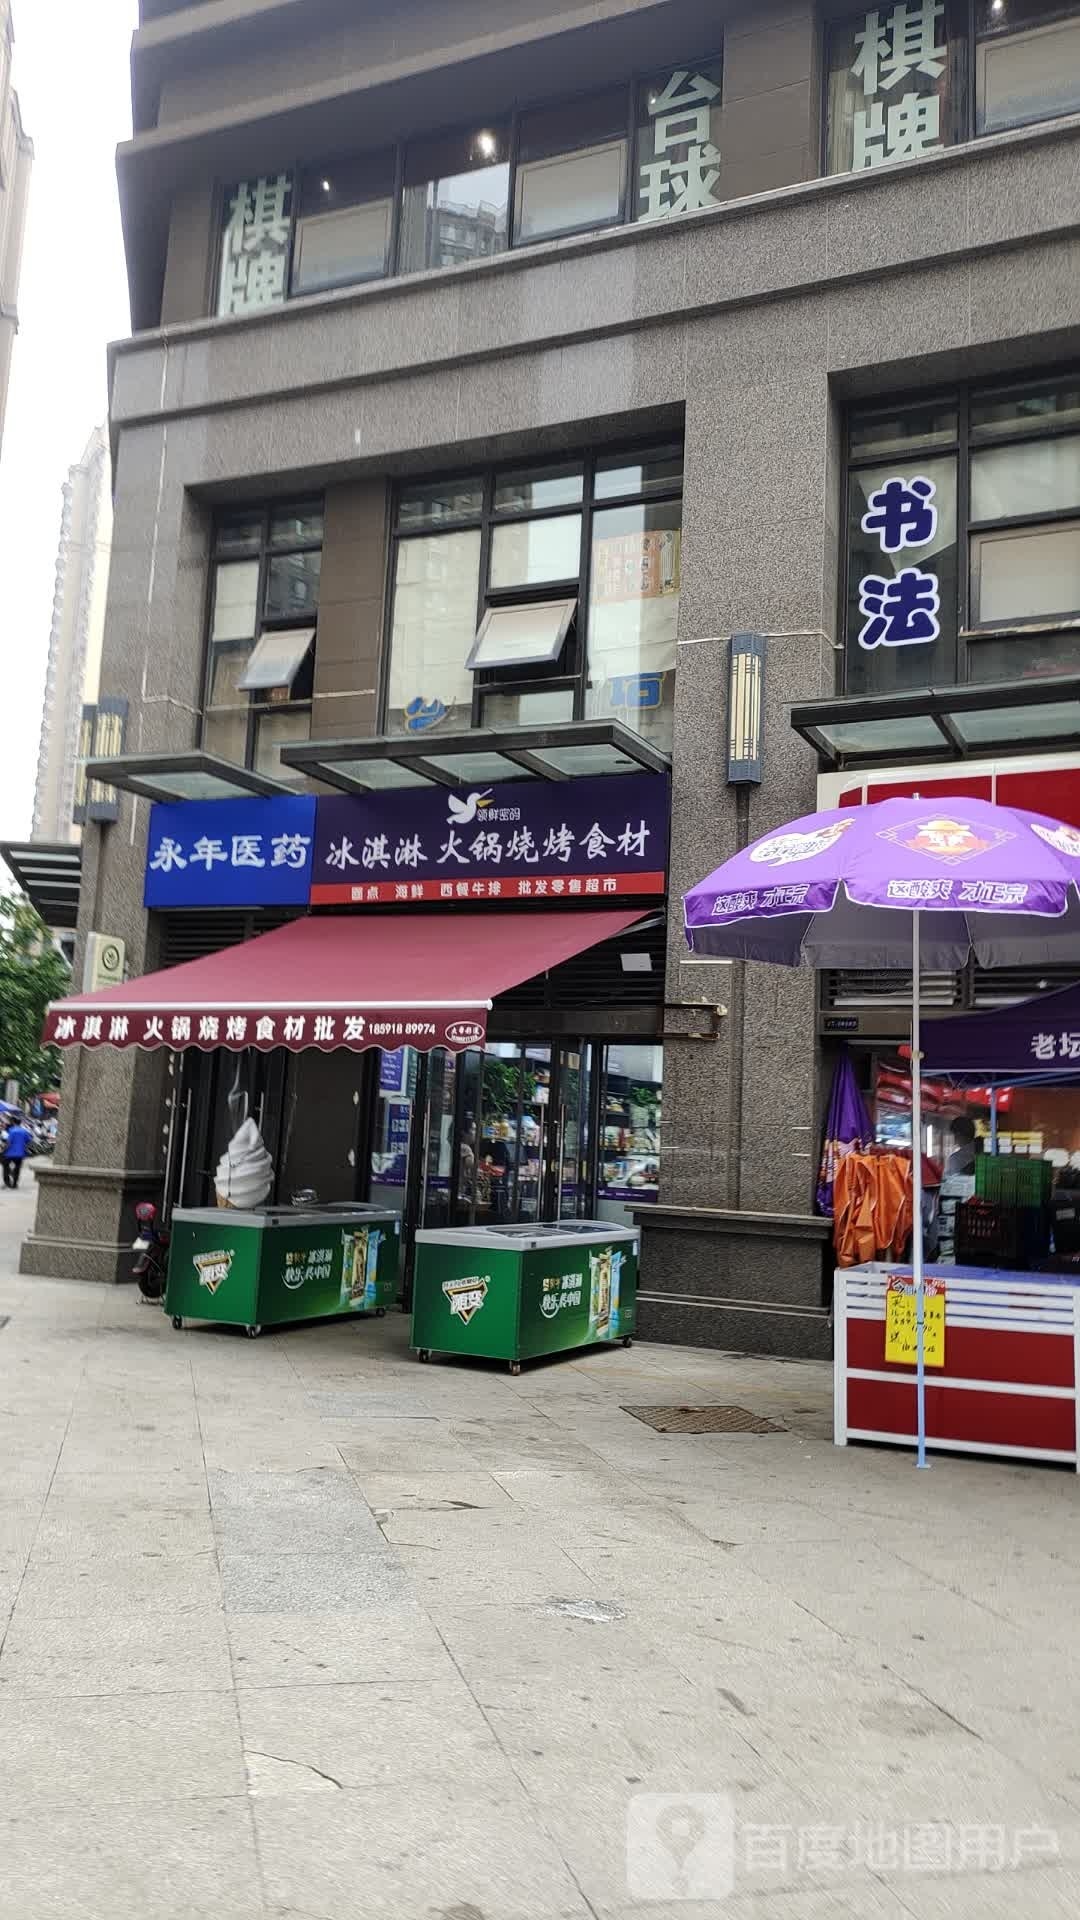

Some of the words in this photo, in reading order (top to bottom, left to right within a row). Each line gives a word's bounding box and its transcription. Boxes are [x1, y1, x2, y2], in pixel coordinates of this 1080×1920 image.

[851, 0, 948, 173] 棋牌
[638, 71, 721, 222] 台球
[218, 174, 292, 318] 棋牌
[859, 477, 939, 649] 书法
[476, 807, 521, 822] 领鲜密码
[149, 832, 312, 873] 永年医药
[325, 832, 428, 870] 冰淇淋
[436, 819, 651, 865] 火锅烧烤食材
[395, 884, 425, 899] 海鲜
[440, 880, 502, 897] 西餐牛排
[518, 877, 618, 895] 批发零售超市
[711, 890, 759, 916] 这酸爽
[760, 883, 811, 908] 才正宗
[887, 879, 953, 900] 这酸爽
[959, 880, 1028, 904] 才正宗
[54, 1015, 129, 1041] 冰淇淋
[143, 1015, 366, 1041] 火锅烧烤食材批发
[1030, 1032, 1080, 1060] 老坛
